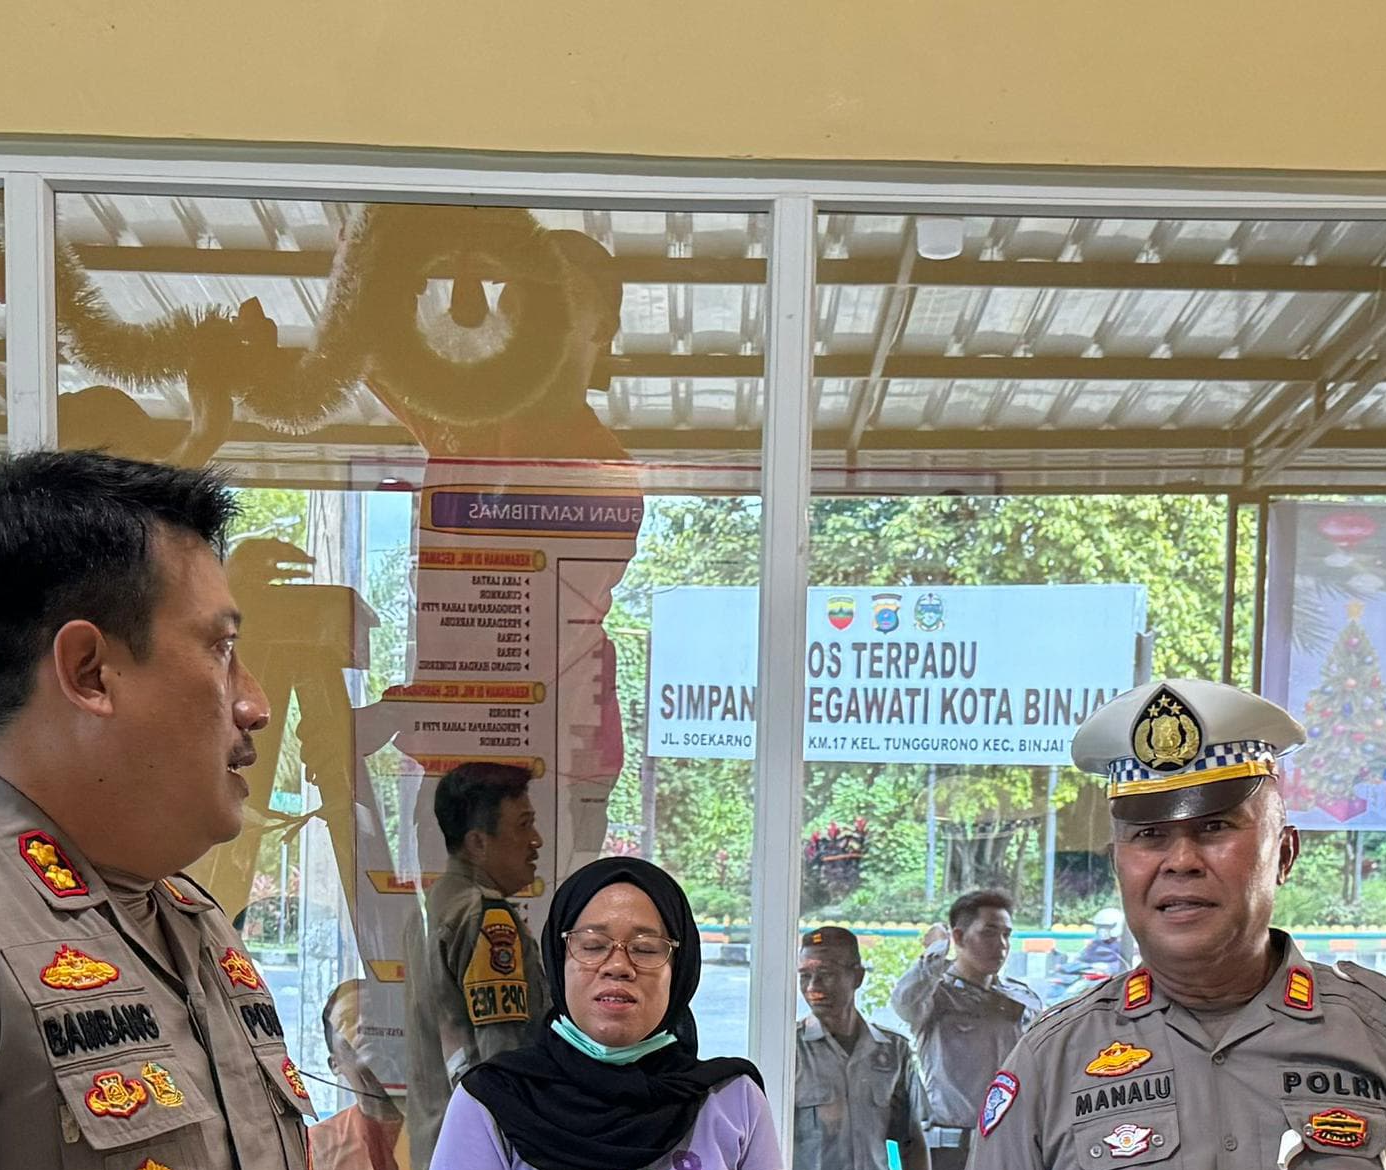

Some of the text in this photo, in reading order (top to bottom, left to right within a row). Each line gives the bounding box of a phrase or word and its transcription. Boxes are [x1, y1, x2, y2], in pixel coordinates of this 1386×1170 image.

[808, 641, 977, 679] OS TERPADU
[660, 683, 756, 721] SIMPAN
[808, 687, 929, 724] EGAWATI
[940, 687, 1013, 725] KOTA
[661, 733, 1064, 752] JL. SOEKARNO KM.17 KEL. TUNGGURONO KEC. BINJAI
[43, 1003, 160, 1057] BAMBANG
[1075, 1075, 1171, 1116] MANALU
[1283, 1071, 1384, 1100] POLRI
